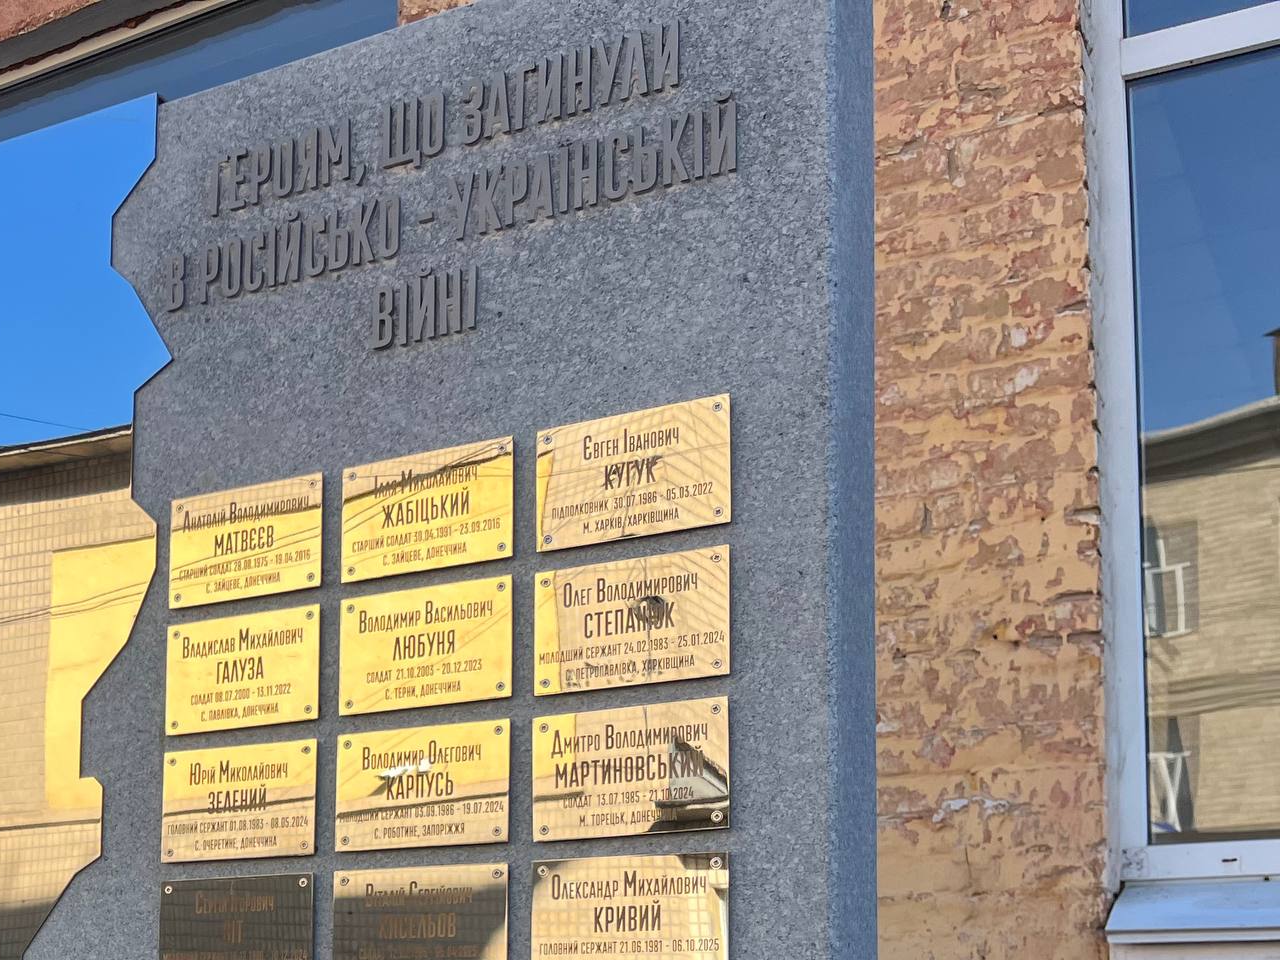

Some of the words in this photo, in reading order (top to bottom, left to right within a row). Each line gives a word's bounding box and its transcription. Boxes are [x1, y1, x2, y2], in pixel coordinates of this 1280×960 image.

[210, 118, 367, 218] ГЕРОЯМ,
[382, 92, 445, 169] ЩО
[461, 18, 681, 147] ЗАГИНУЛИ
[165, 253, 186, 312] В
[199, 198, 402, 305] РОСІЙСЬКО
[450, 92, 738, 242] УКРАЇНСЬКІЙ
[371, 264, 480, 351] ВІЙНІ
[382, 487, 469, 529] ЖАБІЦЬКИЙ
[552, 500, 608, 520] ПІДПОЛКОВНИК
[614, 491, 657, 509] 30.07.1986
[667, 482, 713, 500] 05.03.2022
[628, 508, 679, 527] ХАРКІВЩИНА
[214, 526, 273, 556] МАТВЄЄВ
[352, 534, 384, 553] СТАРШИЙ
[386, 532, 412, 548] СОЛДАТ
[392, 549, 424, 565] ЗАЙЦЕВЕ,
[426, 542, 467, 560] ДОНЕЧЧИНА
[244, 572, 280, 588] ДОНЕЧЧИНА
[393, 629, 455, 661] ЛЮБУНЯ
[539, 647, 583, 665] МОЛОДШИЙ
[586, 643, 621, 659] СЕРЖАНТ
[624, 637, 668, 655] 24.02.1983
[678, 630, 725, 648] 25.01.2024
[216, 656, 264, 684] ГАЛУЗА
[366, 670, 391, 684] СОЛДАТ
[442, 659, 482, 675] 20.12.2023
[642, 655, 695, 673] ХАРКІВЩИНА
[191, 694, 213, 706] СОЛДАТ
[394, 686, 418, 699] ТЕРНИ,
[420, 680, 460, 697] ДОНЕЧЧИНА
[242, 702, 279, 718] ДОНЕЧЧИНА
[555, 746, 704, 789] МАРТИНОВСЬКИЙ
[387, 772, 453, 800] КАРПУСЬ
[563, 795, 592, 808] СОЛДАТ
[598, 791, 639, 806] 13.07.1985
[649, 786, 694, 802] 21.10.2024
[208, 785, 267, 814] ЗЕЛЕНИЙ
[463, 801, 504, 815] 19.07.2024
[168, 821, 198, 835] ГОЛОВНИЙ
[200, 821, 228, 833] СЕРЖАНТ
[271, 816, 308, 828] 08.05.2024
[383, 825, 420, 839] РОБОТИНЕ,
[423, 822, 465, 837] ЗАПОРІЖЖЯ
[591, 813, 628, 827] ТОРЕЦЬК,
[240, 835, 277, 849] ДОНЕЧЧИНА
[594, 900, 661, 932] КРИВИЙ
[539, 942, 578, 955] ГОЛОВНИЙ
[581, 941, 617, 954] СЕРЖАНТ
[620, 941, 662, 953] 21.06.1981
[672, 939, 719, 951] 06.10.2025
